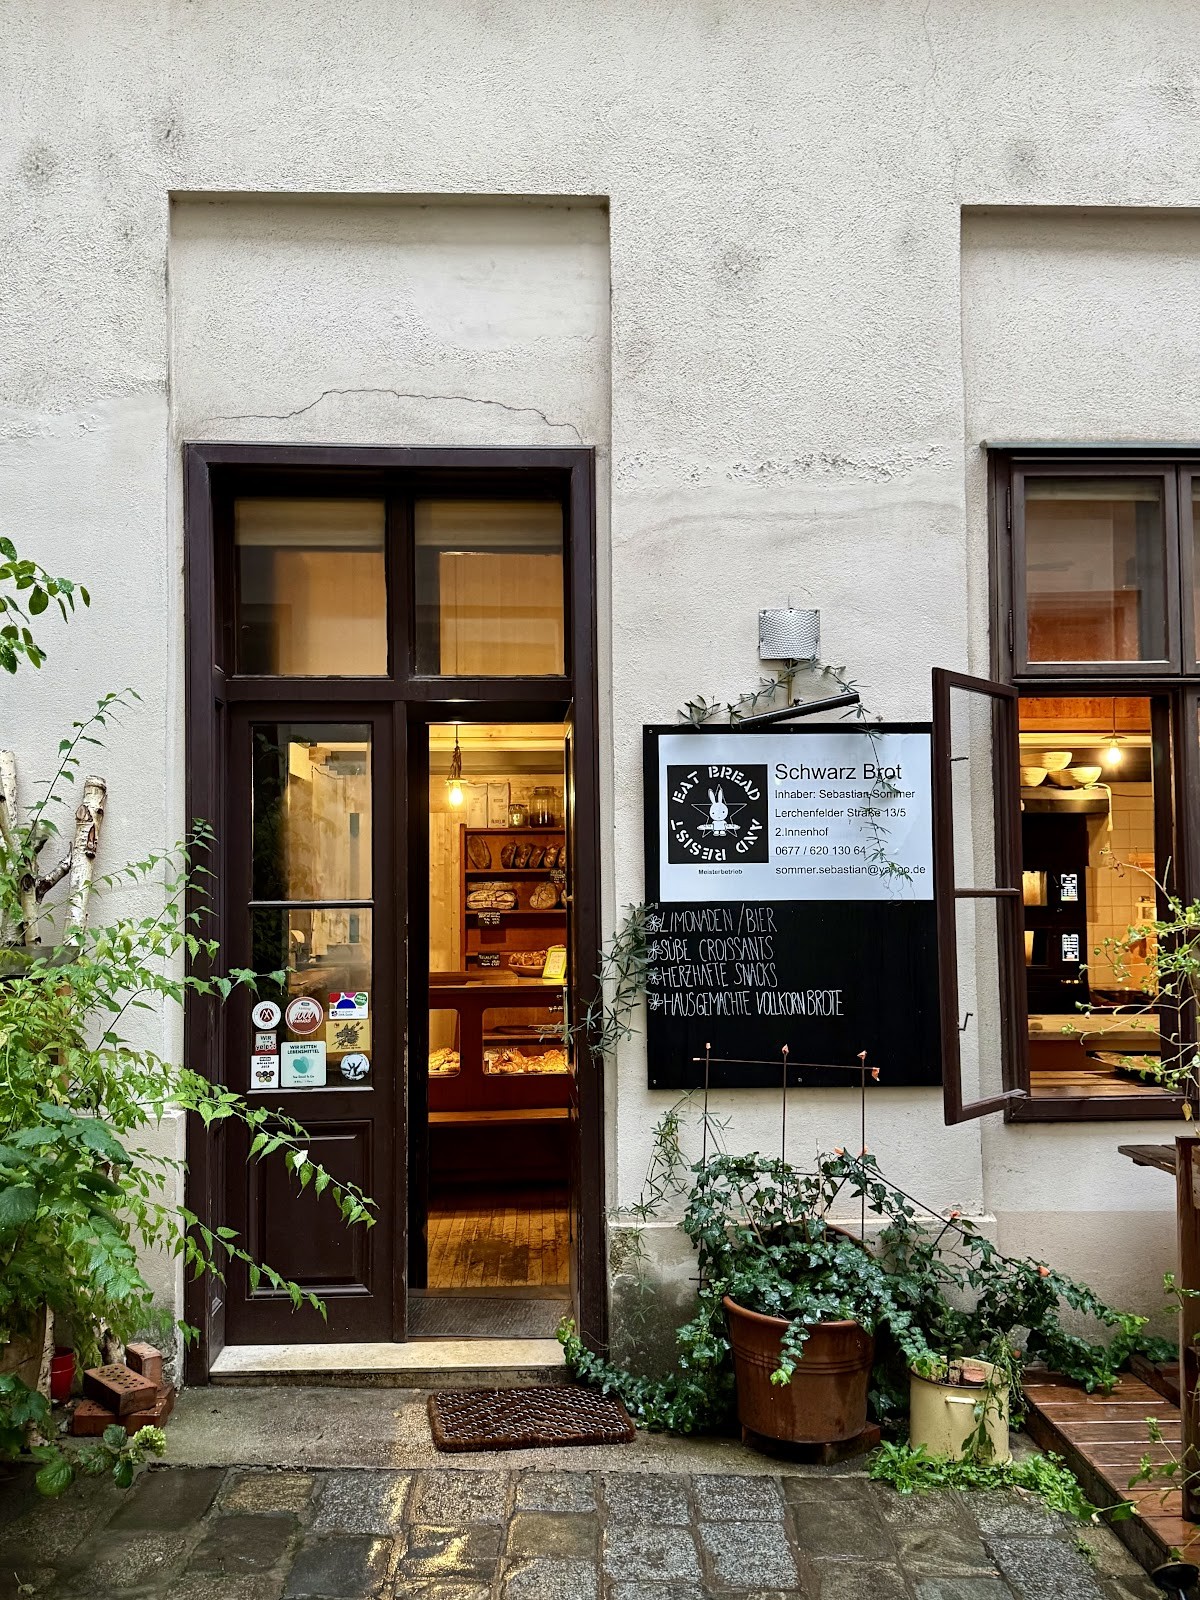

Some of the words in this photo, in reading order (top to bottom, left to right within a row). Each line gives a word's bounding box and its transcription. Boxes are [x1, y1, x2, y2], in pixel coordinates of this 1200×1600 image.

[708, 765, 761, 801] BREAD
[775, 763, 857, 780] Schwarz
[863, 763, 902, 780] Brot
[672, 770, 699, 804] EAT
[775, 789, 816, 799] Inhaber:
[819, 789, 869, 799] Sebastian
[775, 808, 844, 818] Lerchenfelder
[885, 808, 907, 818] 13/5
[670, 819, 727, 861] RESIST
[735, 818, 763, 853] AND
[775, 827, 829, 837] 2.Innenhof
[775, 846, 800, 856] 0677
[810, 846, 829, 856] 620
[832, 846, 851, 856] 130
[853, 846, 866, 856] 64
[775, 864, 926, 877] sommer.sebastian@yaoo.de
[660, 908, 733, 933] LIMONADEN
[699, 935, 774, 962] CROISSANTS
[661, 962, 729, 988] HERZHAFTE
[733, 962, 778, 988] SNACKS
[663, 990, 752, 1017] HAUSGEMACHTE
